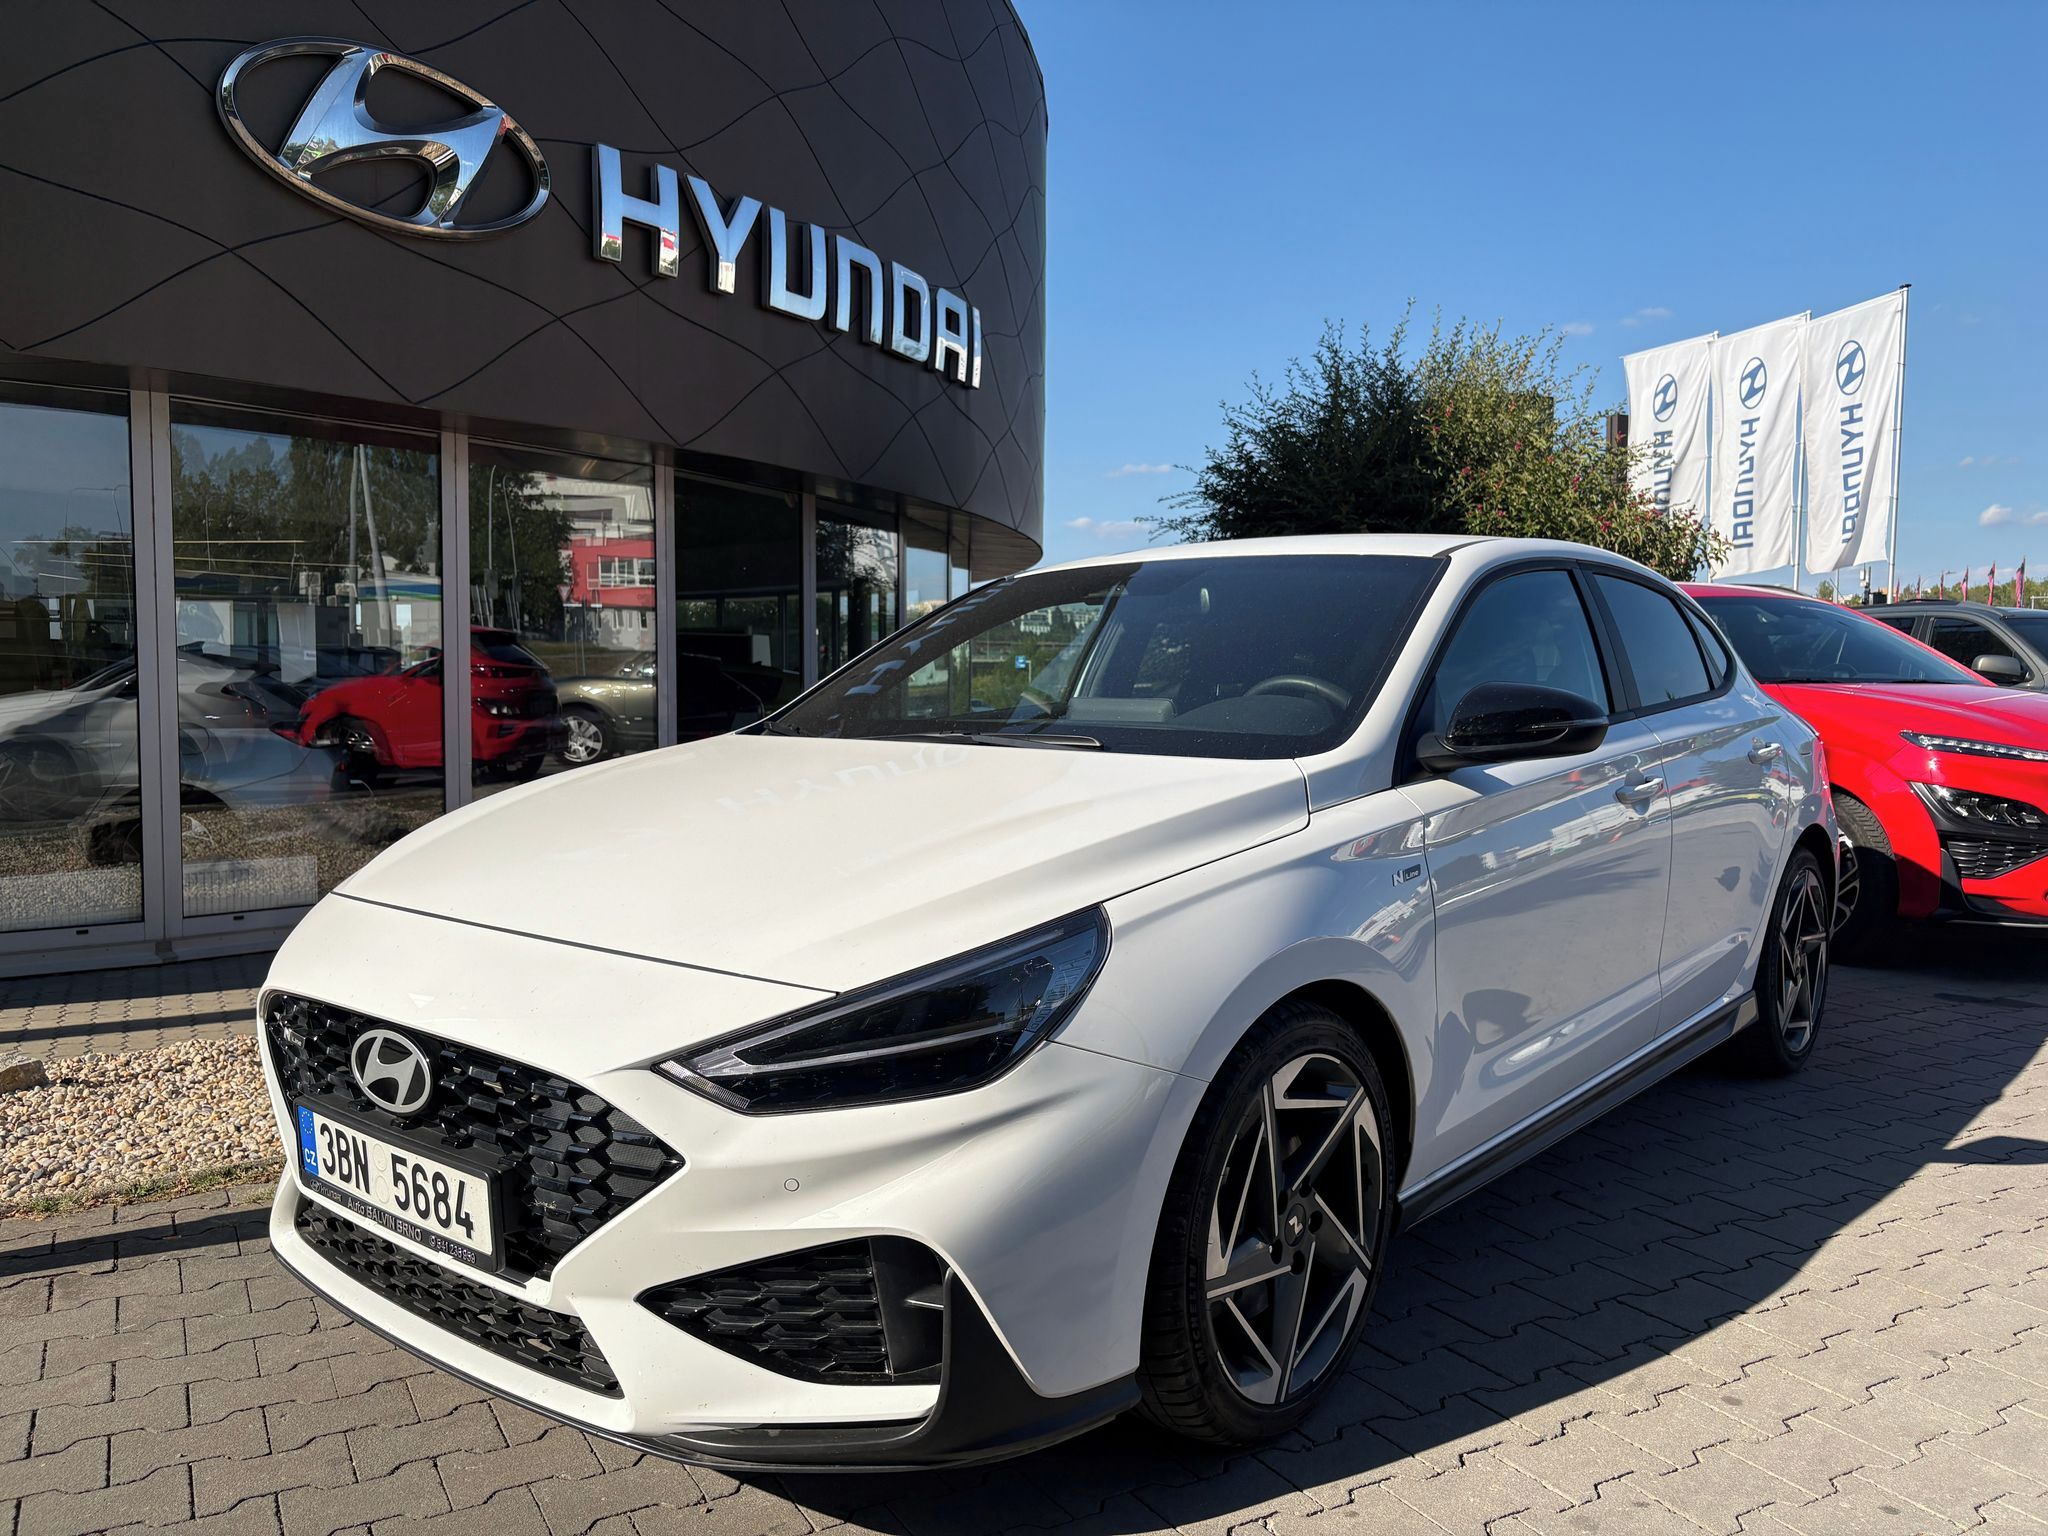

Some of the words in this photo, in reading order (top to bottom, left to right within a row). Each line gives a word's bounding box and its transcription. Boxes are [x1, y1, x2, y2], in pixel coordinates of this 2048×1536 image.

[593, 142, 982, 389] HYUNDAI
[304, 1148, 317, 1167] CZ
[320, 1123, 371, 1195] 3BN
[391, 1153, 474, 1240] 5684
[347, 1197, 365, 1215] Auto
[366, 1206, 395, 1231] BALVIN
[396, 1219, 422, 1242] BRNO
